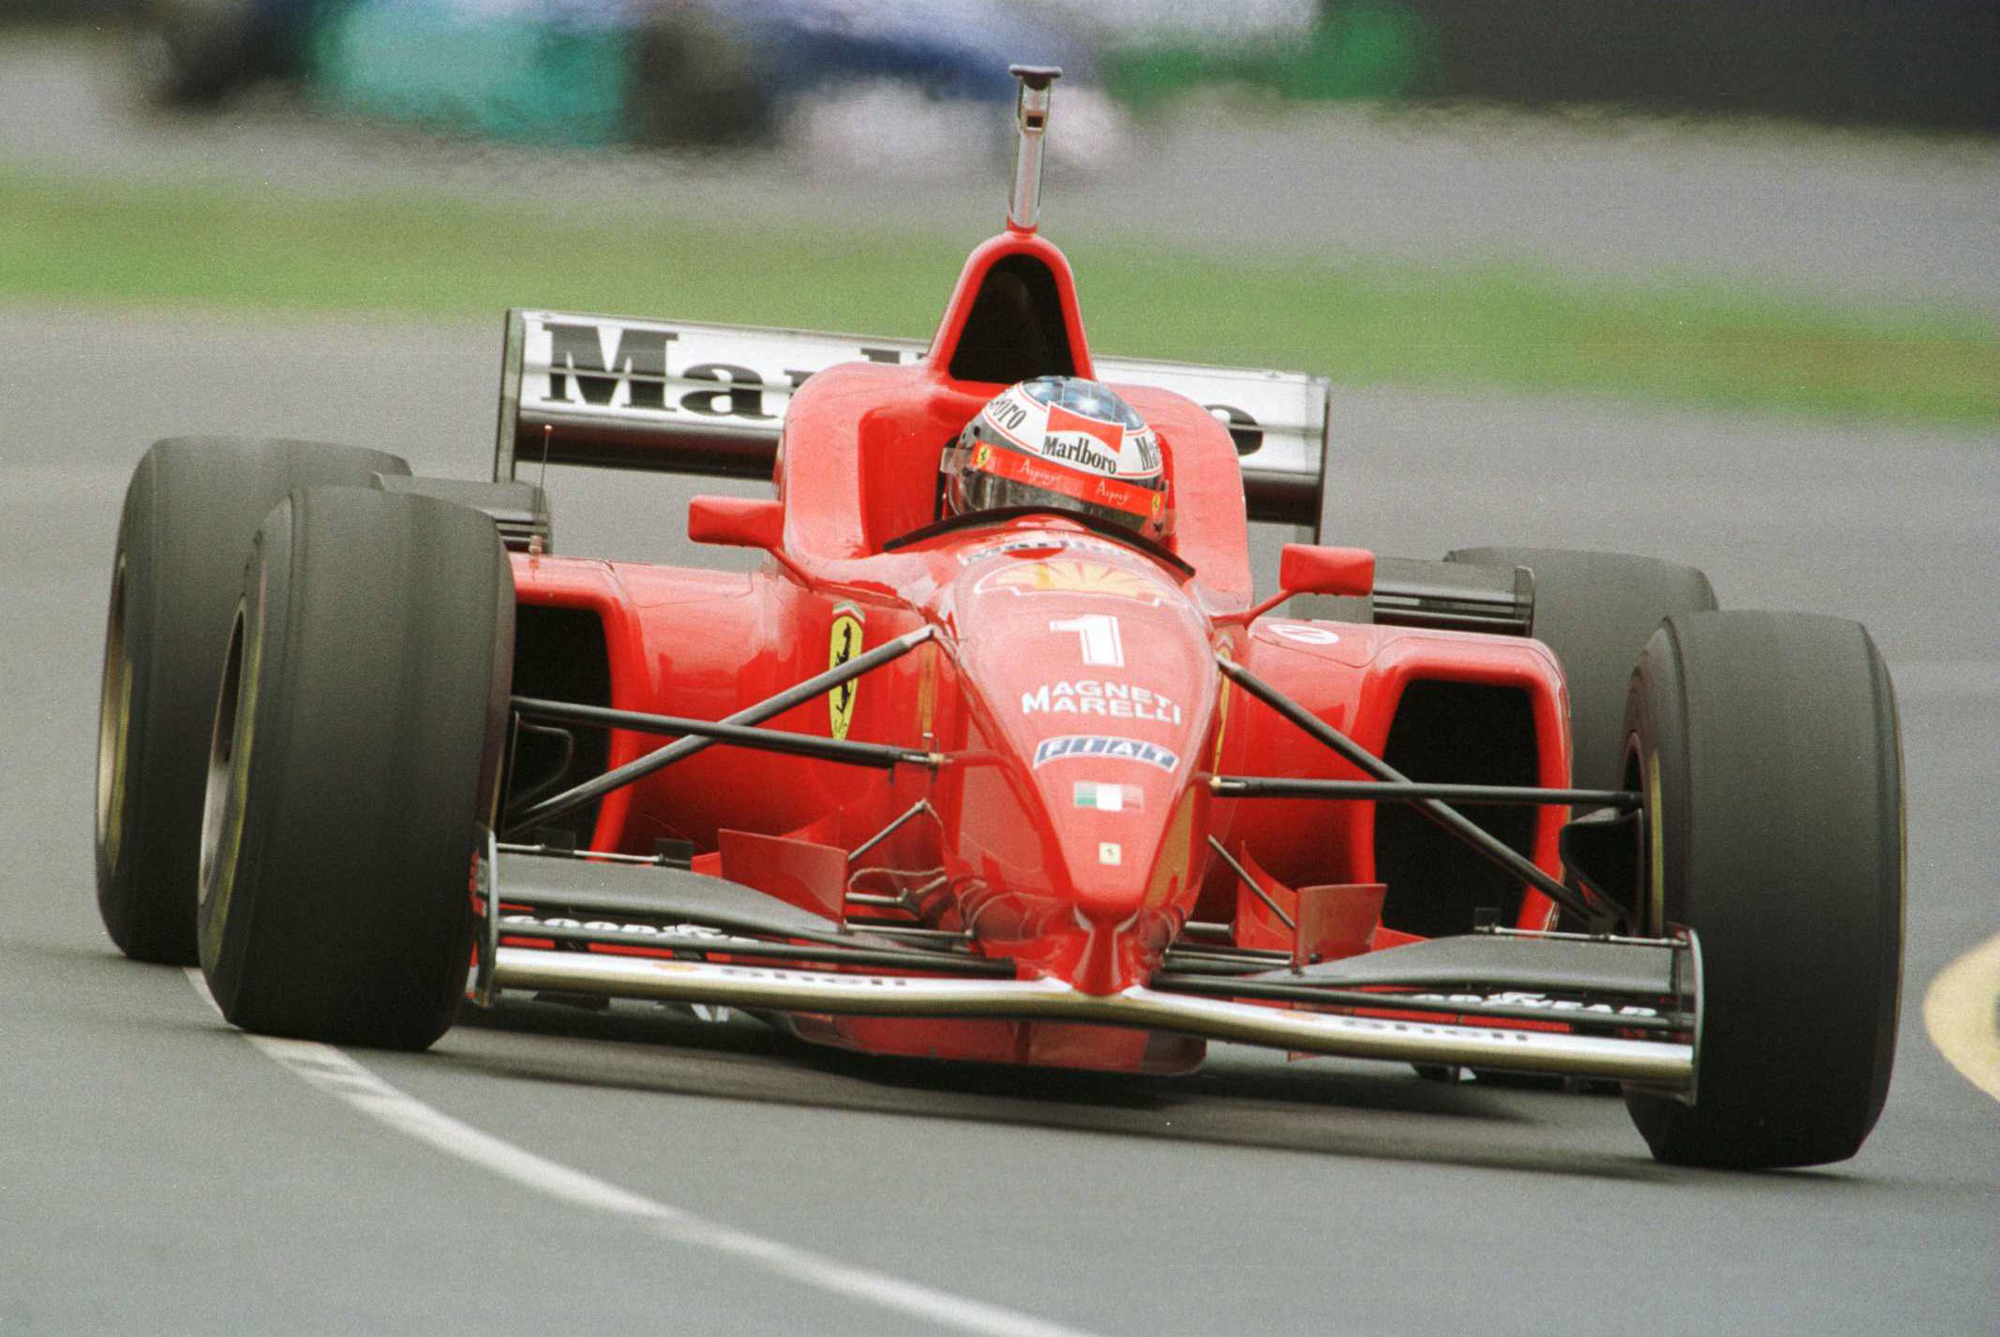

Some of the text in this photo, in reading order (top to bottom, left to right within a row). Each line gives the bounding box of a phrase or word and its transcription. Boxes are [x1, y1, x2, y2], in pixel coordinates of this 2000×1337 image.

[1041, 436, 1117, 474] Marlboro
[1050, 614, 1124, 668] 1
[1021, 684, 1182, 725] MARELLI
[1044, 737, 1174, 766] FIAT
